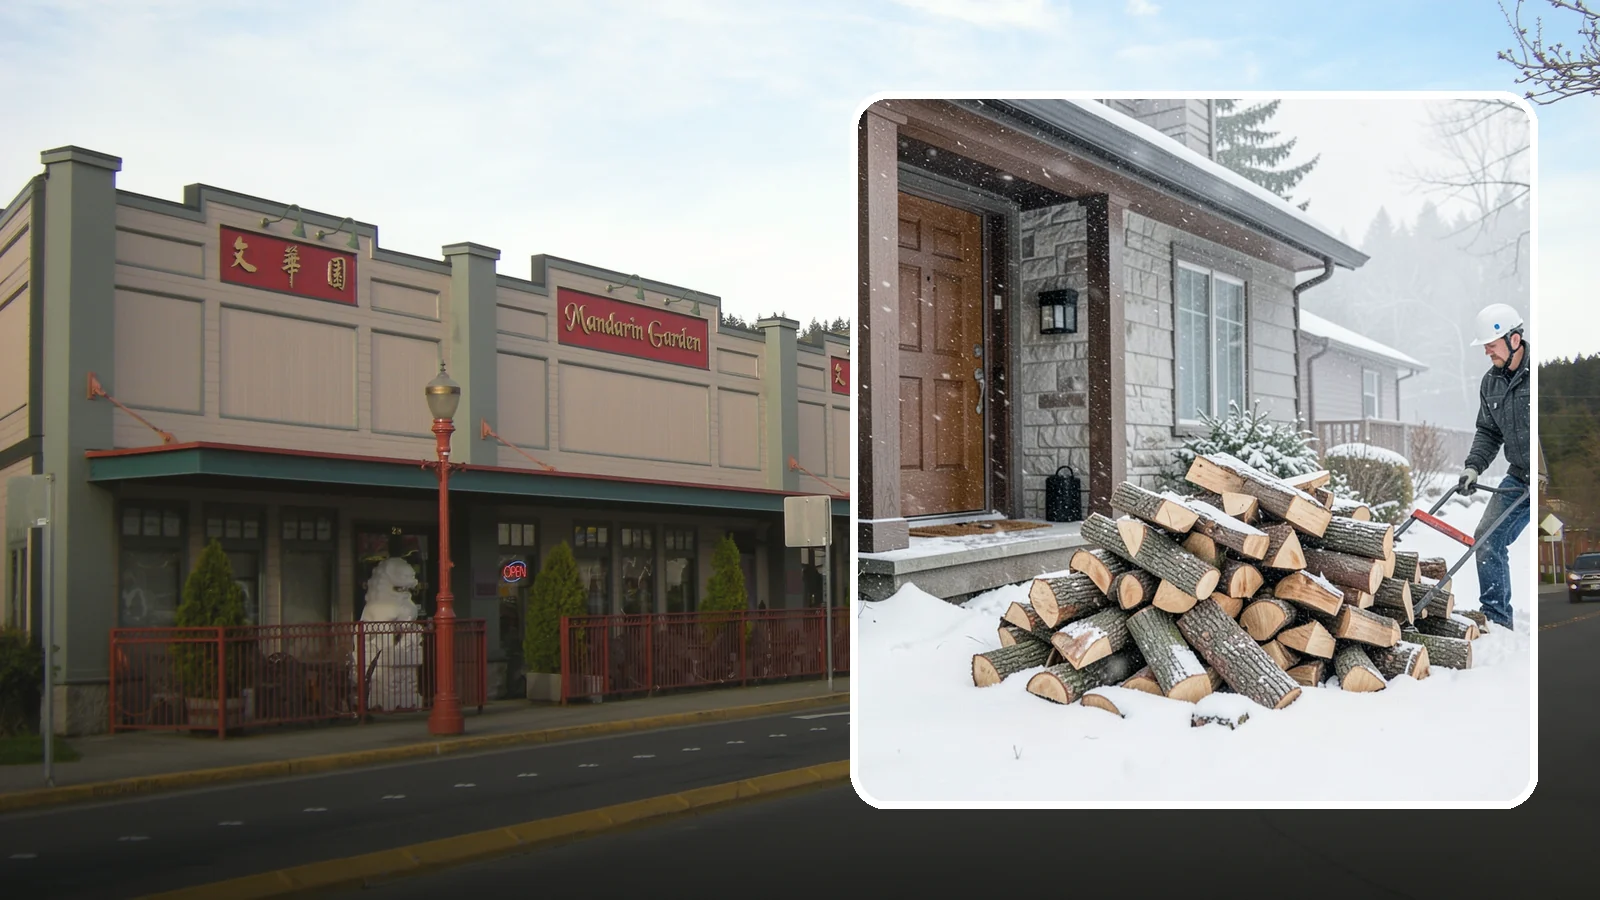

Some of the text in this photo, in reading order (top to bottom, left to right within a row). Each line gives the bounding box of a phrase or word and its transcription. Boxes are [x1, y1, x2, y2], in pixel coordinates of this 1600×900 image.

[231, 235, 346, 291] 文華園
[564, 302, 702, 352] Mandarin Garden
[834, 362, 847, 387] 文
[503, 565, 527, 578] OPEN
